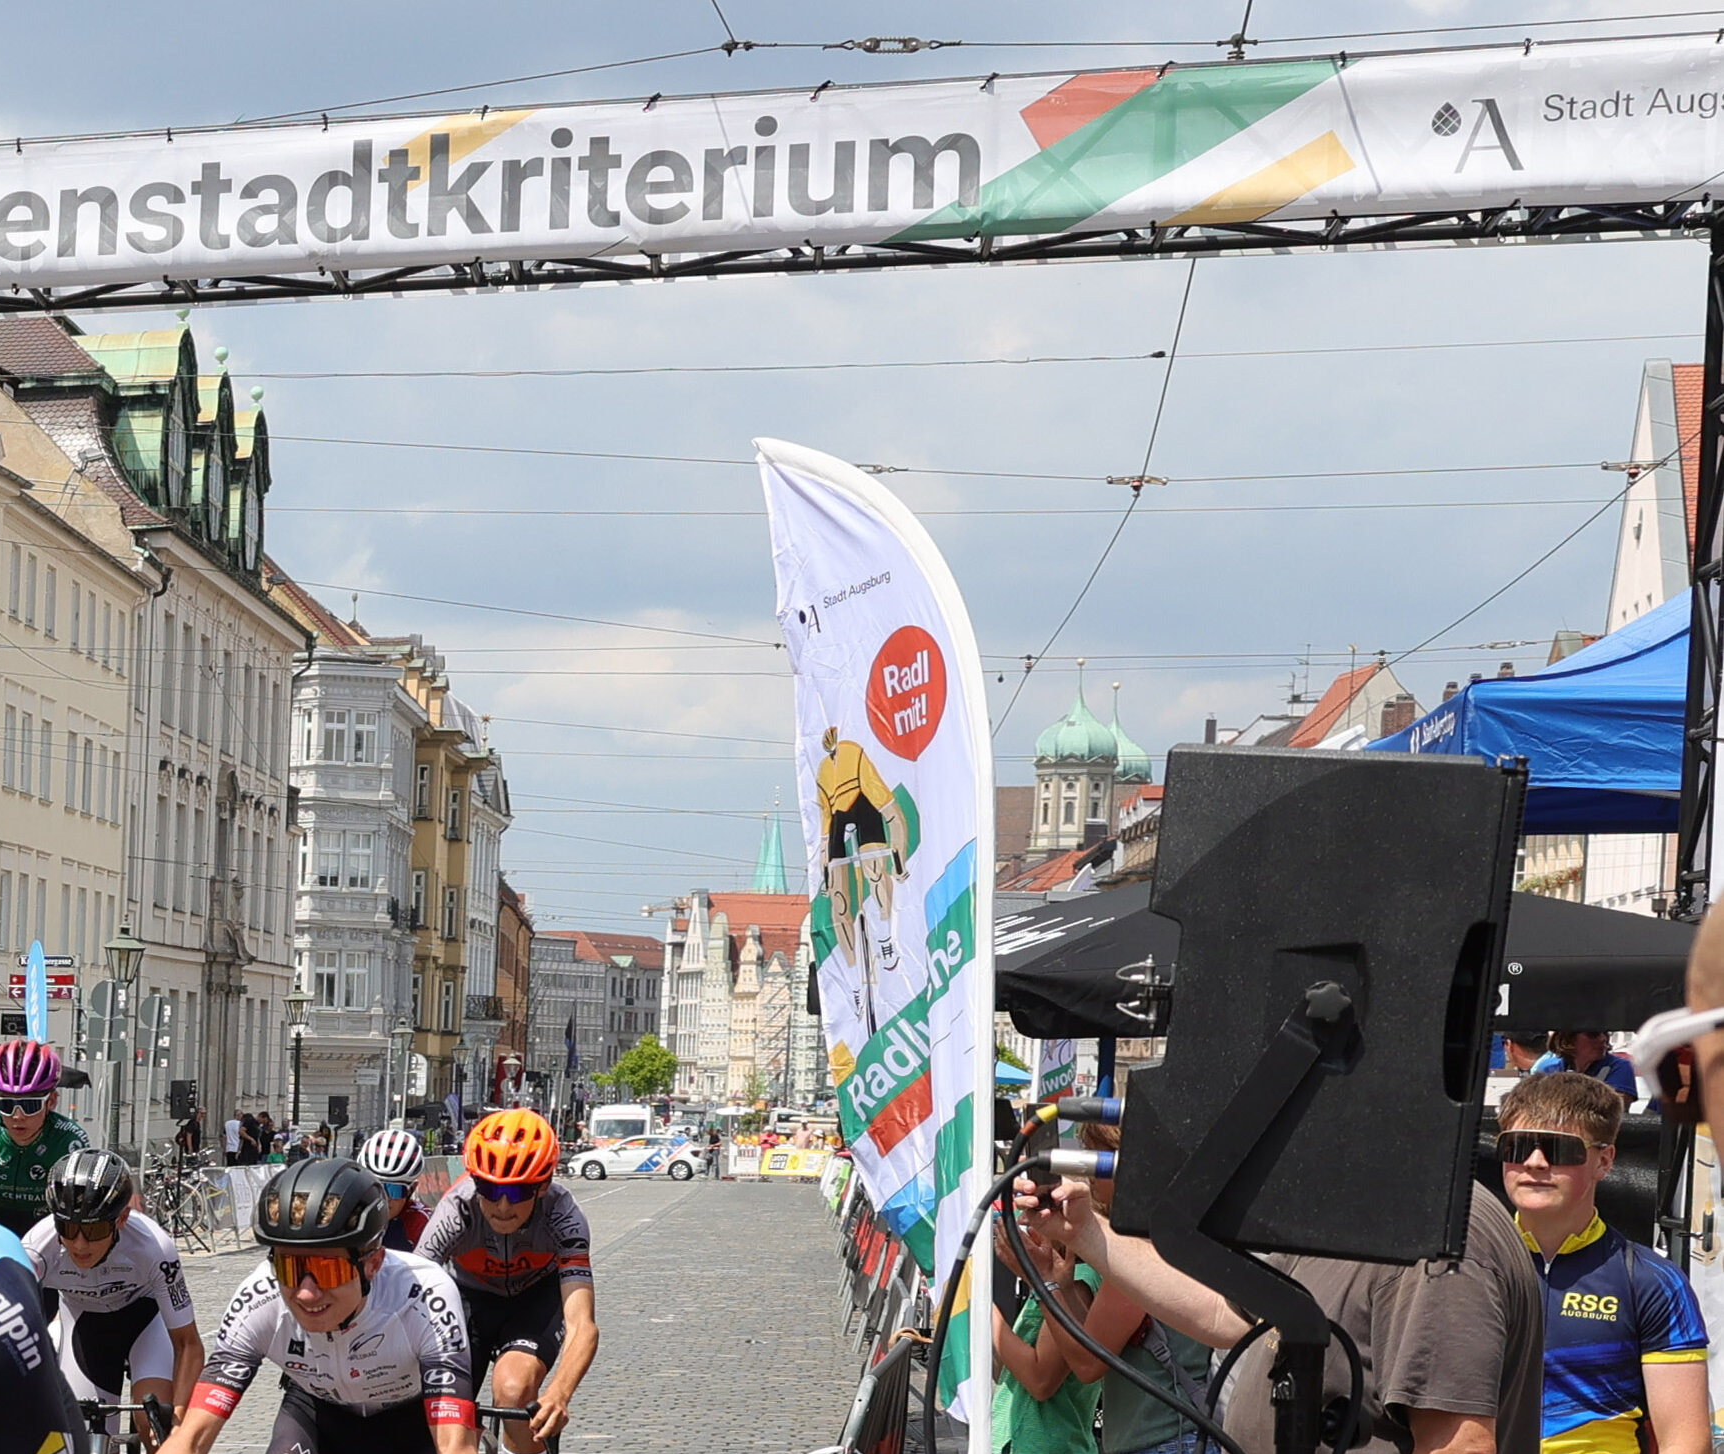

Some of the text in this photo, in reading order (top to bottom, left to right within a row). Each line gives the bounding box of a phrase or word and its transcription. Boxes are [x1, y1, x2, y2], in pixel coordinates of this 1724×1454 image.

[1543, 86, 1724, 122] Stadt Aug
[823, 570, 892, 610] Stadt Augsburg
[883, 649, 931, 699] Radl
[893, 693, 929, 737] mit!
[53, 1118, 91, 1149] BIORAC
[217, 1275, 281, 1342] BROSCH
[408, 1282, 466, 1354] BROSCH
[1560, 1310, 1617, 1322] AUGSBURG
[1561, 1292, 1619, 1314] RSG
